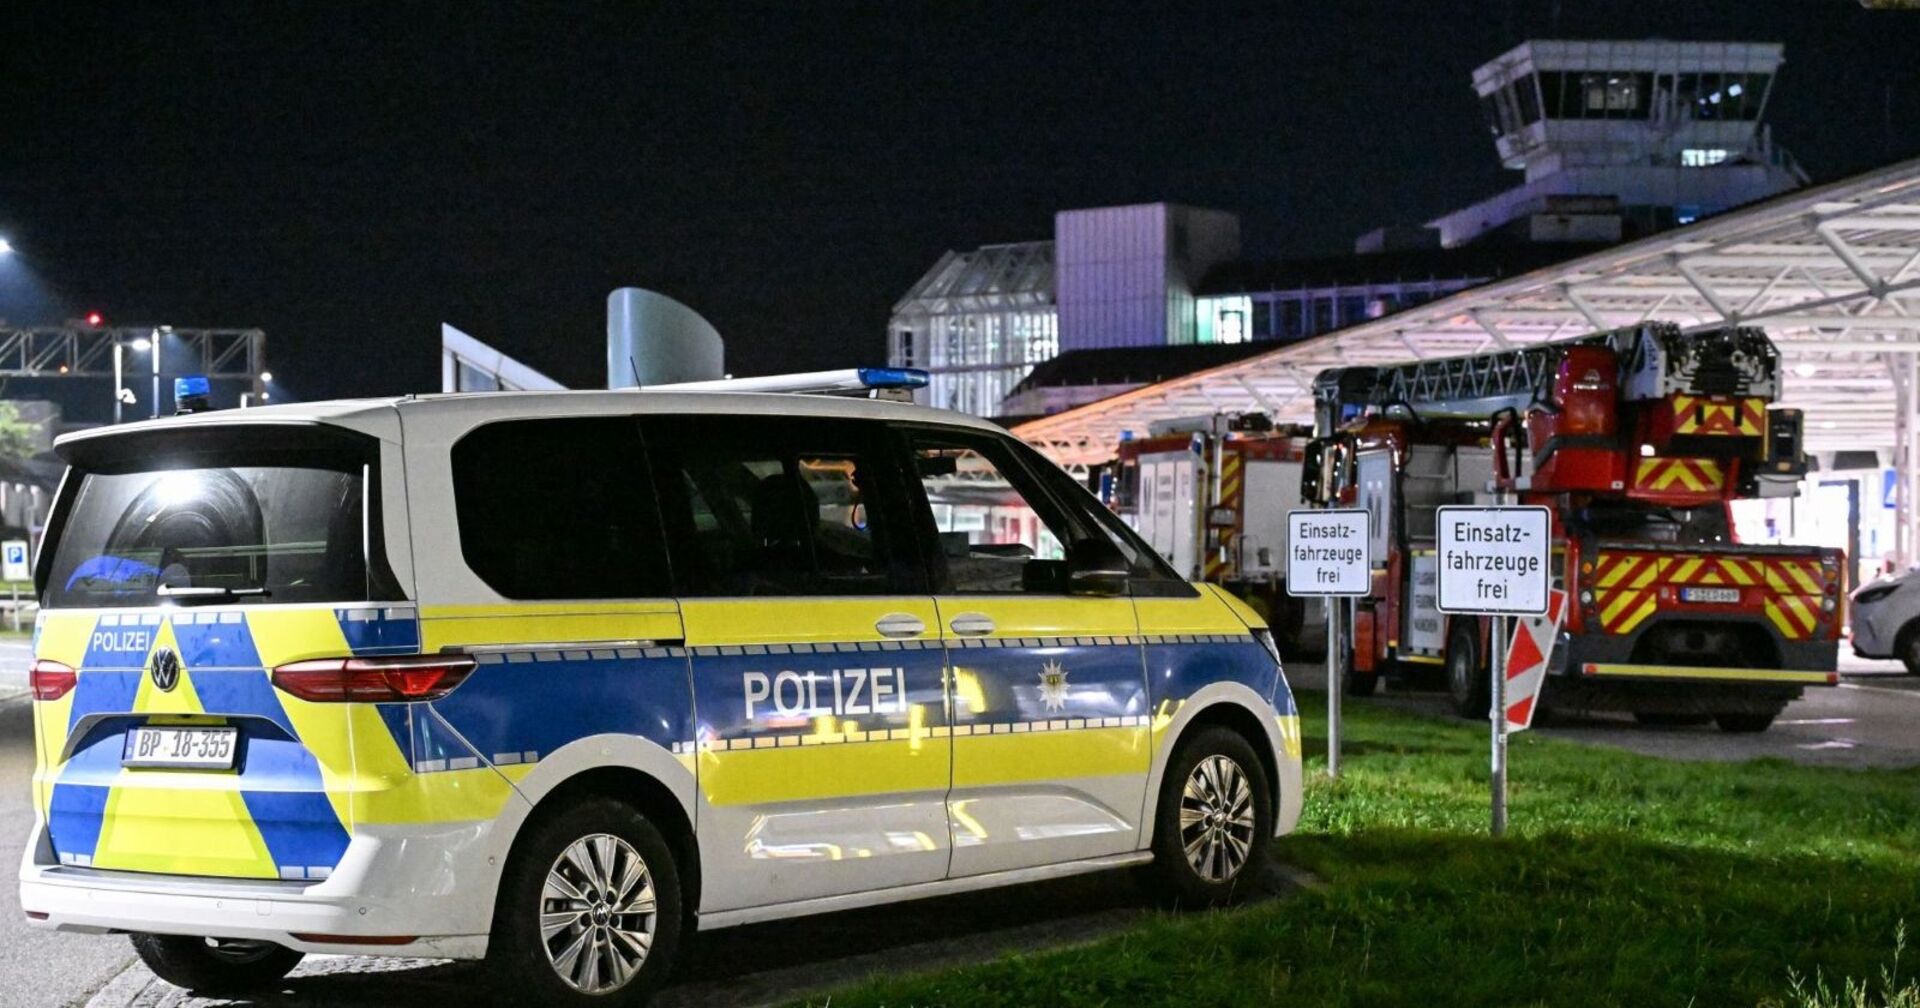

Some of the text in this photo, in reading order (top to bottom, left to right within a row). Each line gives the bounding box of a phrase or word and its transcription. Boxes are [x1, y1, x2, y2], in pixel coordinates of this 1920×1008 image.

[1300, 522, 1356, 539] Einsatz-
[1454, 522, 1530, 543] Einsatz-
[1294, 545, 1363, 565] fahrzeuge
[1447, 551, 1539, 576] fahrzeuge
[1317, 567, 1341, 583] frei
[1477, 579, 1508, 599] frei
[93, 631, 150, 652] POLIZEI
[743, 667, 907, 719] POLIZEI
[138, 729, 231, 758] BP 18-355
